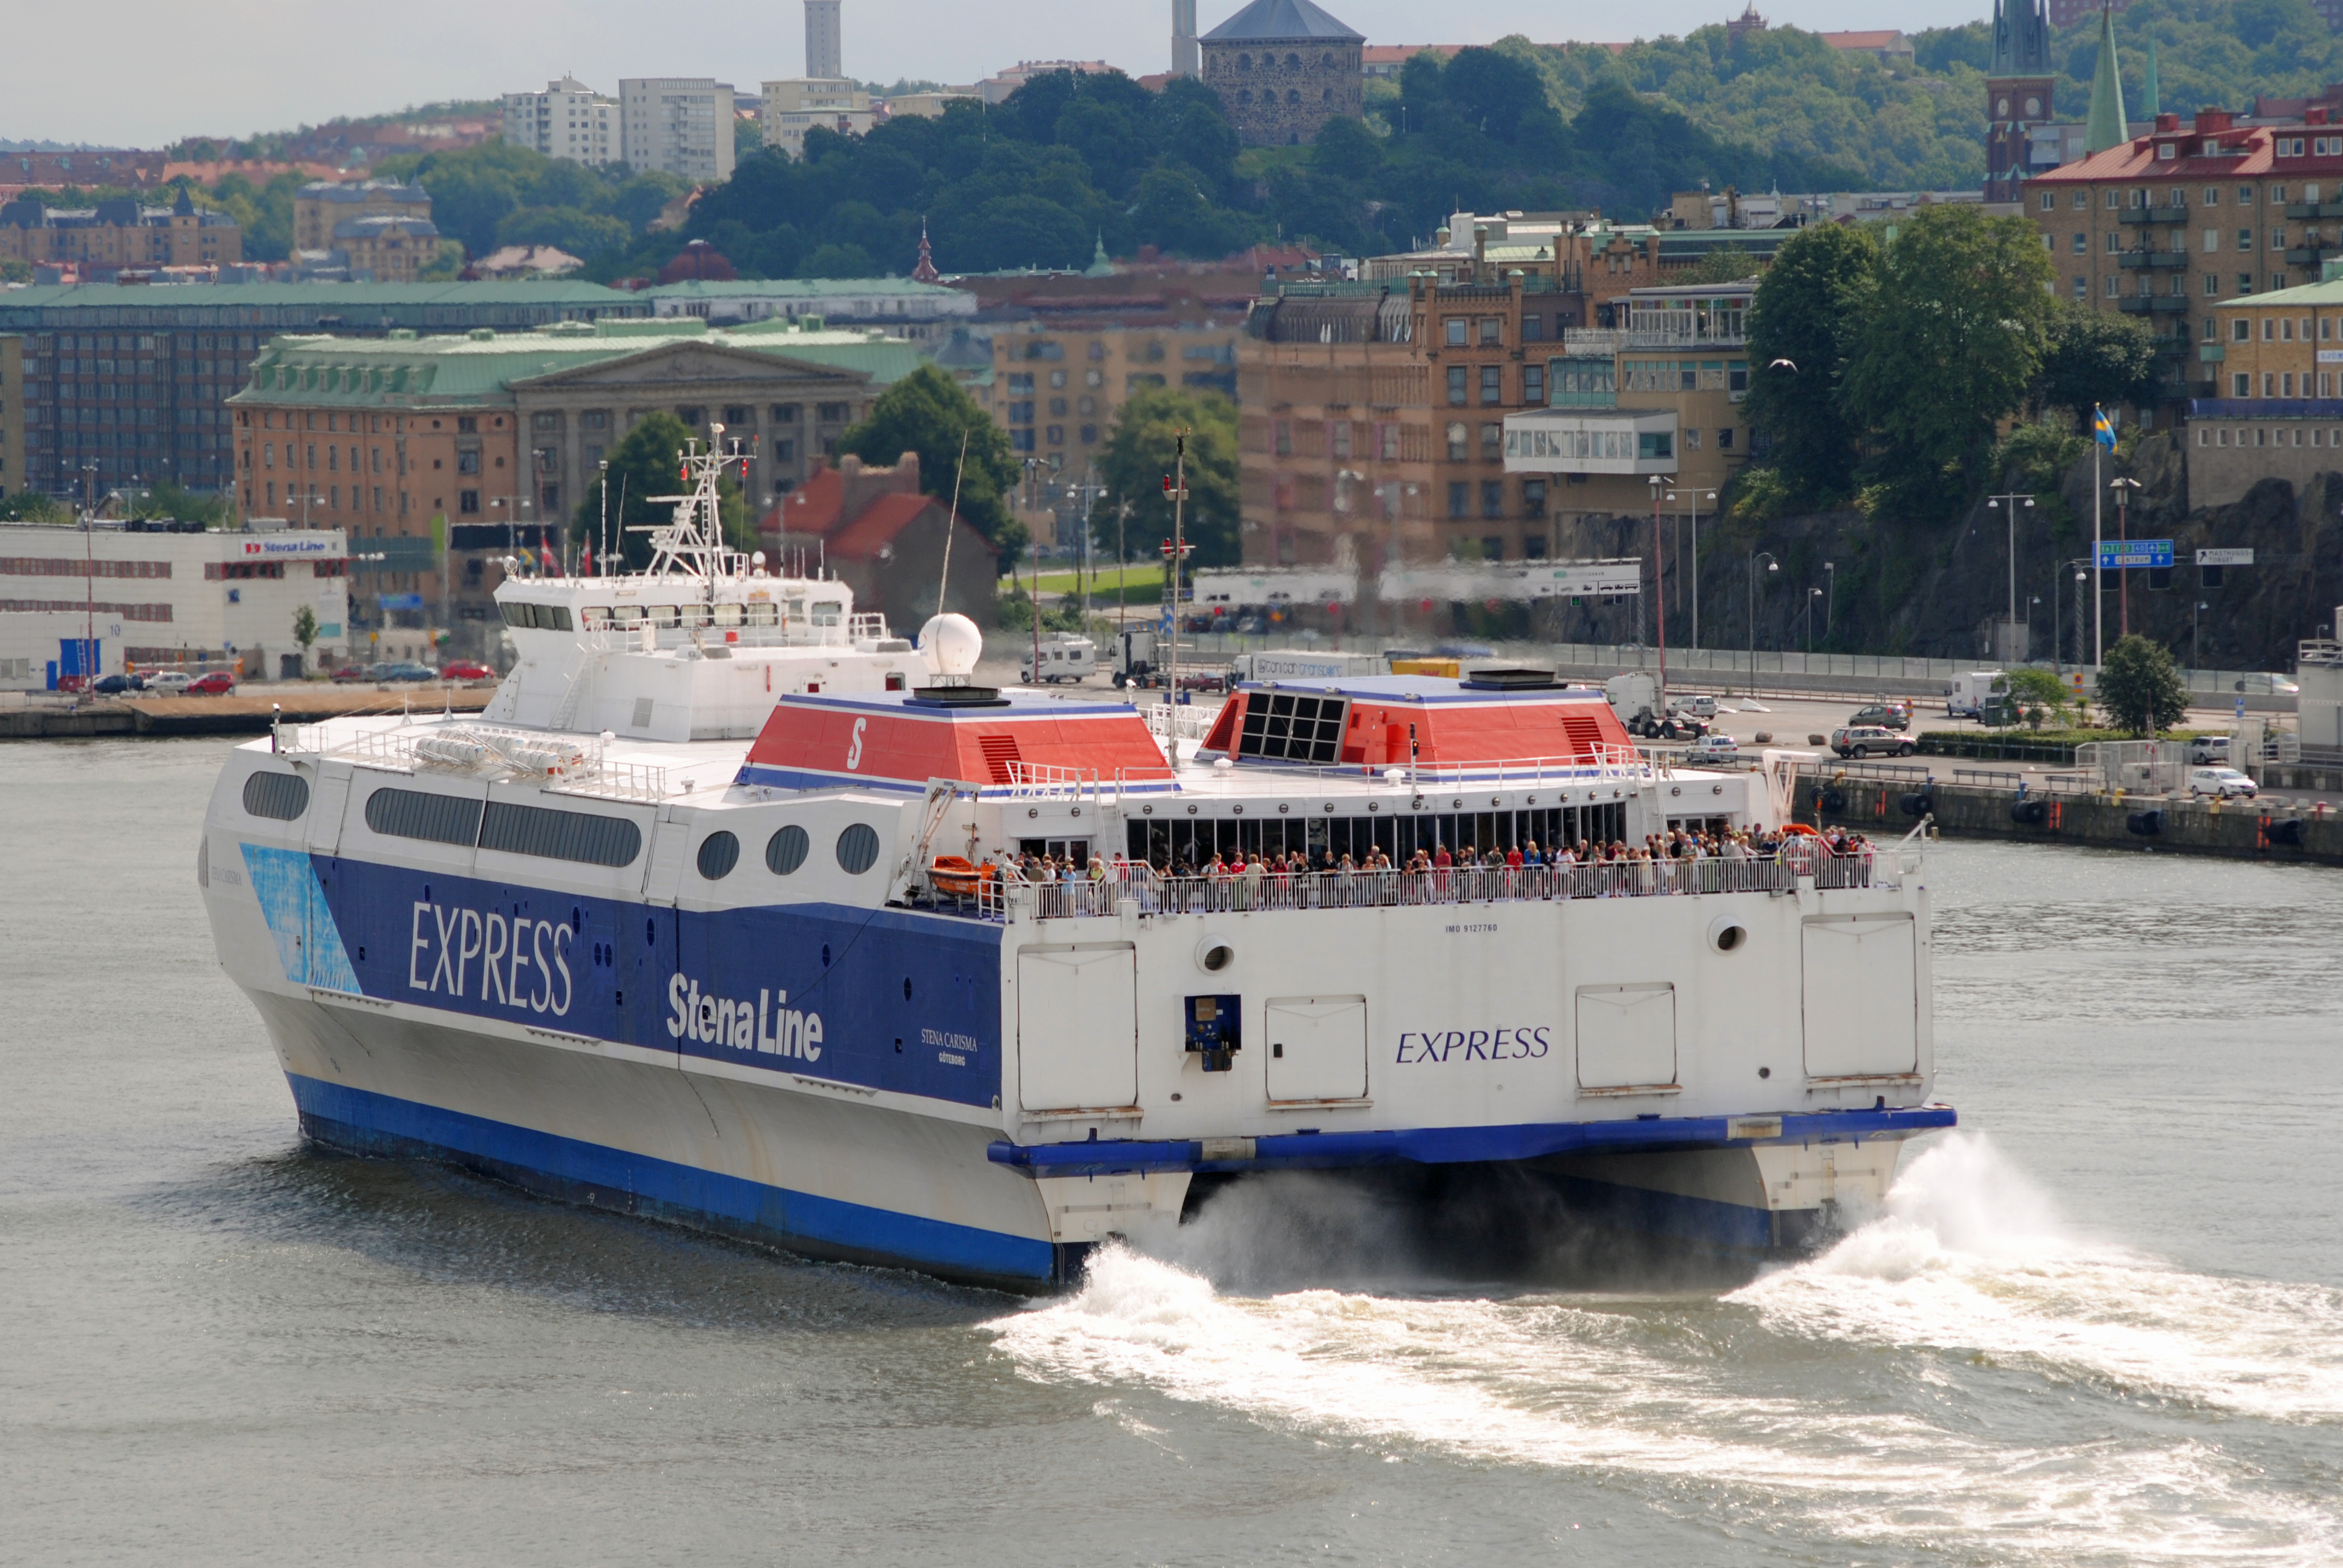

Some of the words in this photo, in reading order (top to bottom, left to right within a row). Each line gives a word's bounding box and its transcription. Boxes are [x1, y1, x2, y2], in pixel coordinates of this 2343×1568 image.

[110, 624, 120, 636] 10
[1464, 924, 1498, 932] 9127760
[409, 901, 572, 1016] EXPRESS
[921, 1028, 943, 1046] STENA
[944, 1032, 977, 1052] CARISMA
[1396, 1025, 1550, 1064] EXPRESS
[939, 1051, 965, 1067] GÖTEBORG
